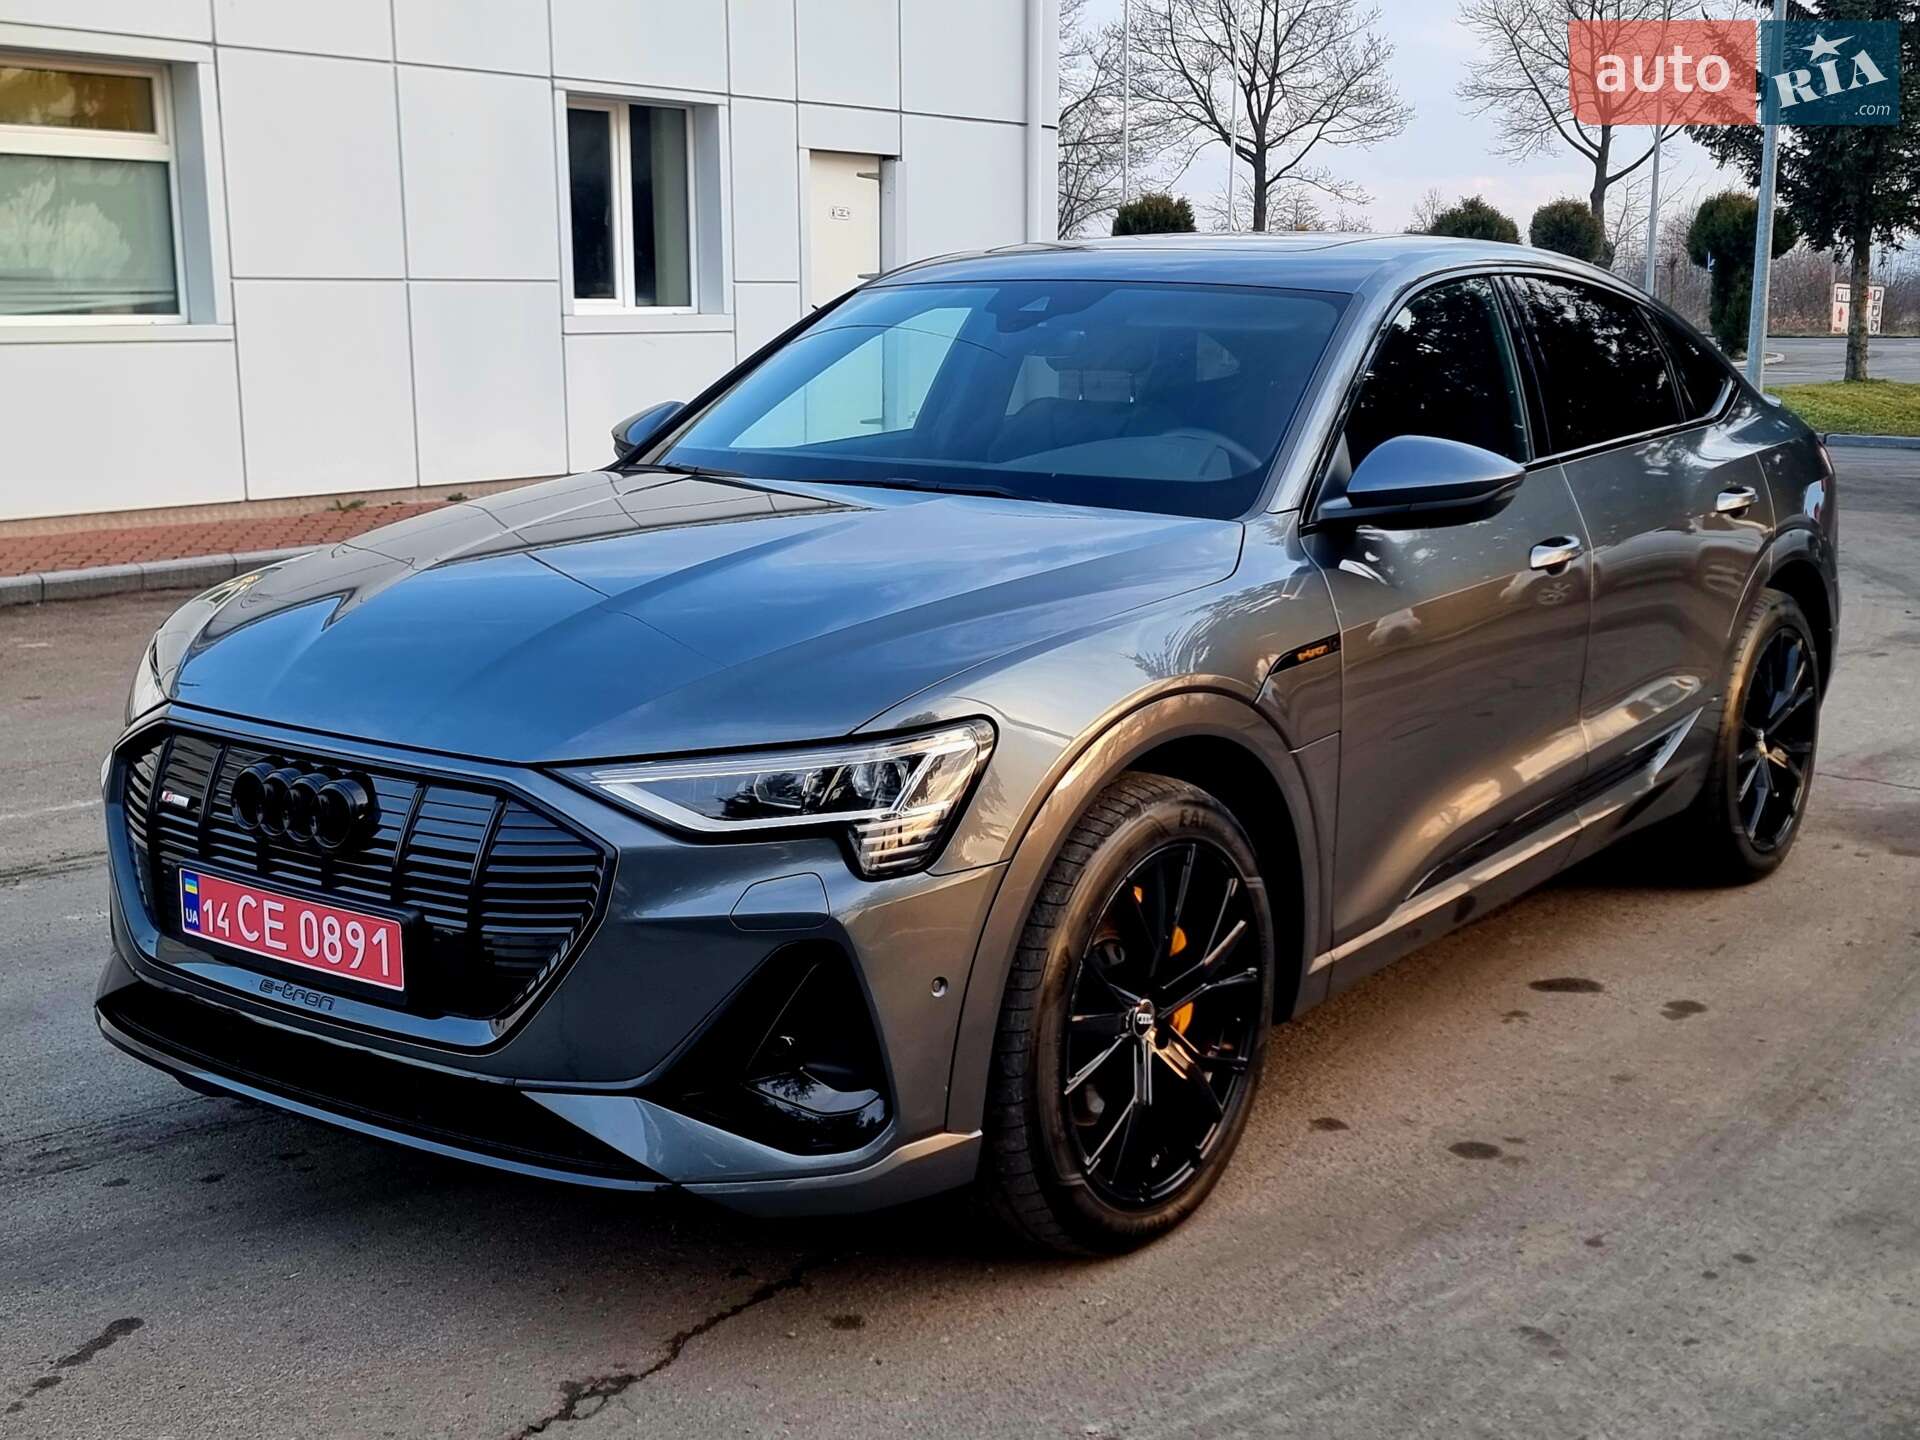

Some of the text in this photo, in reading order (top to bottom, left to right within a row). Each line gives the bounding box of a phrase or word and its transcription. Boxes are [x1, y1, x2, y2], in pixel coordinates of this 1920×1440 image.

[185, 909, 199, 925] UA
[299, 910, 389, 977] 0891
[259, 978, 335, 1011] e-tron
